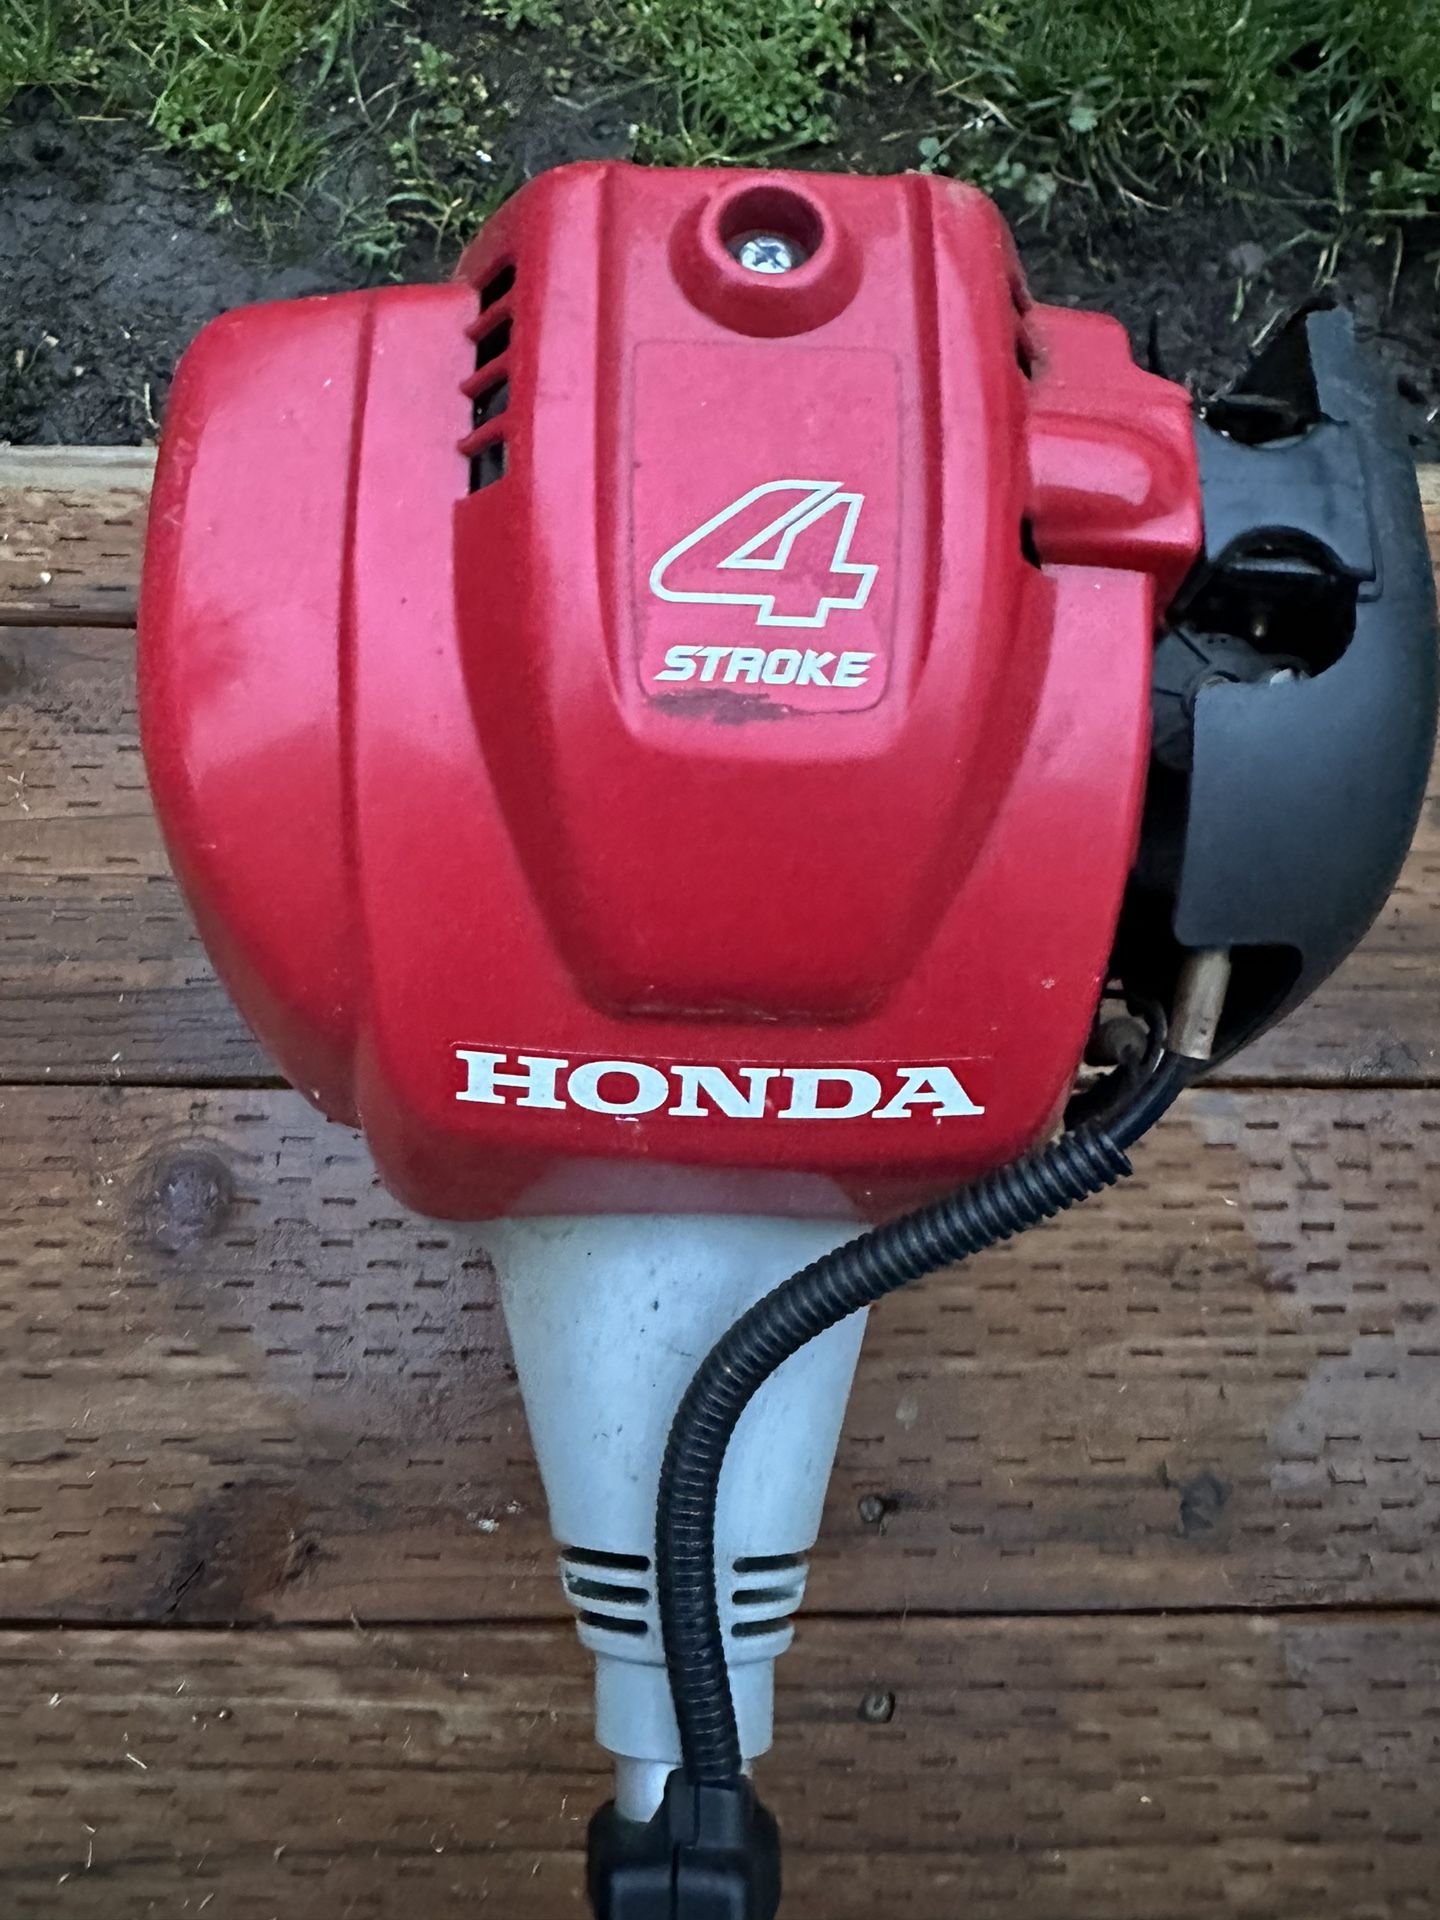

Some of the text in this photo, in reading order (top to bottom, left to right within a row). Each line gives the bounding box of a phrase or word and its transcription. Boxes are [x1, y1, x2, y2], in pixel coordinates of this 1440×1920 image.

[649, 479, 880, 628] 4
[653, 645, 877, 688] STROKE
[455, 1049, 985, 1120] HONDA
